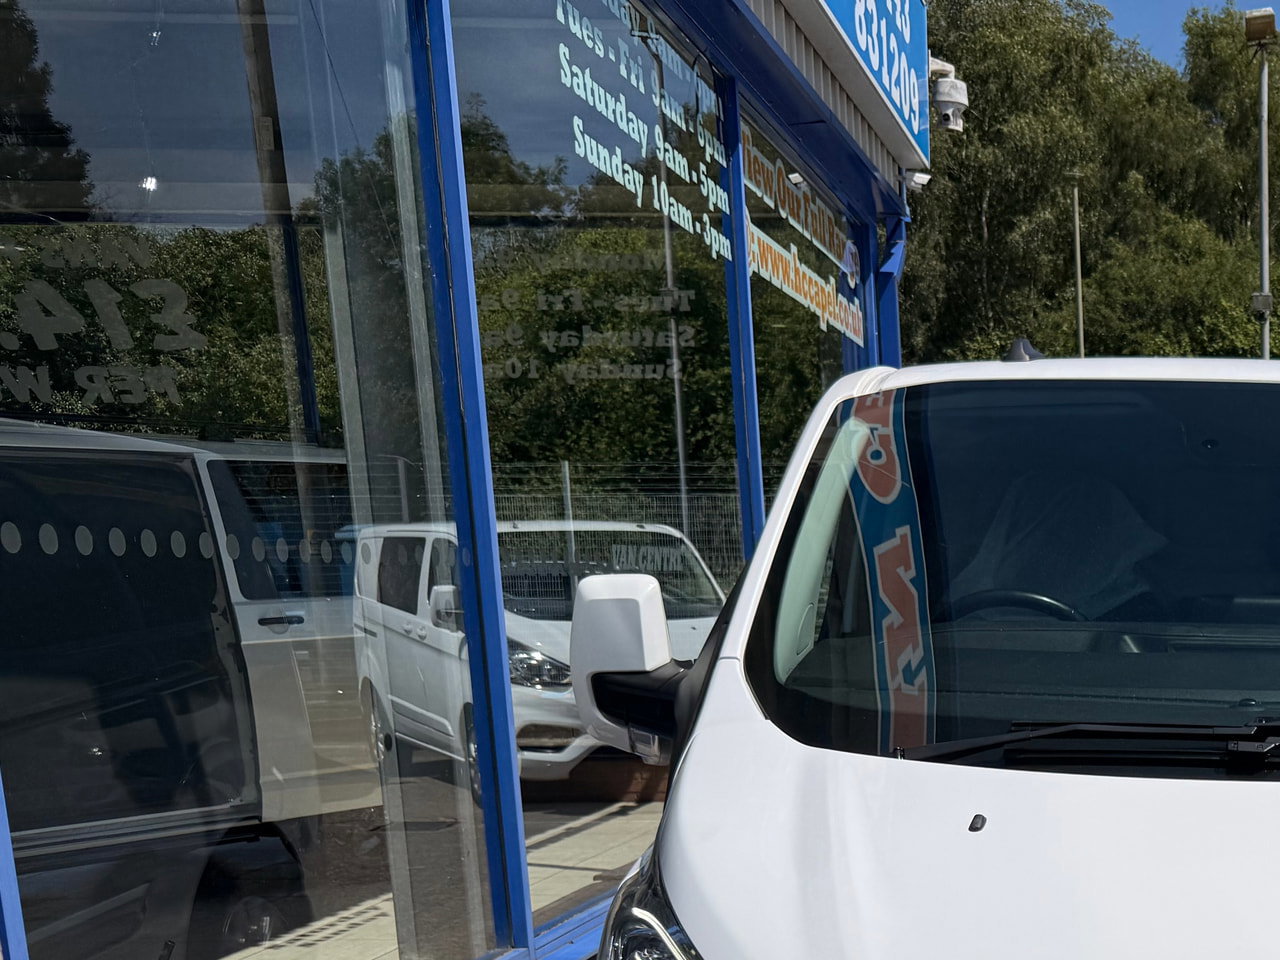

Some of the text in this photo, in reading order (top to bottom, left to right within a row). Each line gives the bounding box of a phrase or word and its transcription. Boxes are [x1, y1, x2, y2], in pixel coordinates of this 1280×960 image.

[556, 0, 605, 58] Tues
[618, 37, 645, 95] Fri
[651, 69, 686, 131] 9am
[697, 112, 727, 168] 6pm
[559, 43, 648, 158] Saturday
[655, 124, 691, 184] 9am
[700, 162, 730, 216] 5pm
[854, 0, 919, 135] 831209
[573, 115, 644, 209] Sunday
[652, 174, 694, 235] 10am
[703, 213, 732, 262] 3pm
